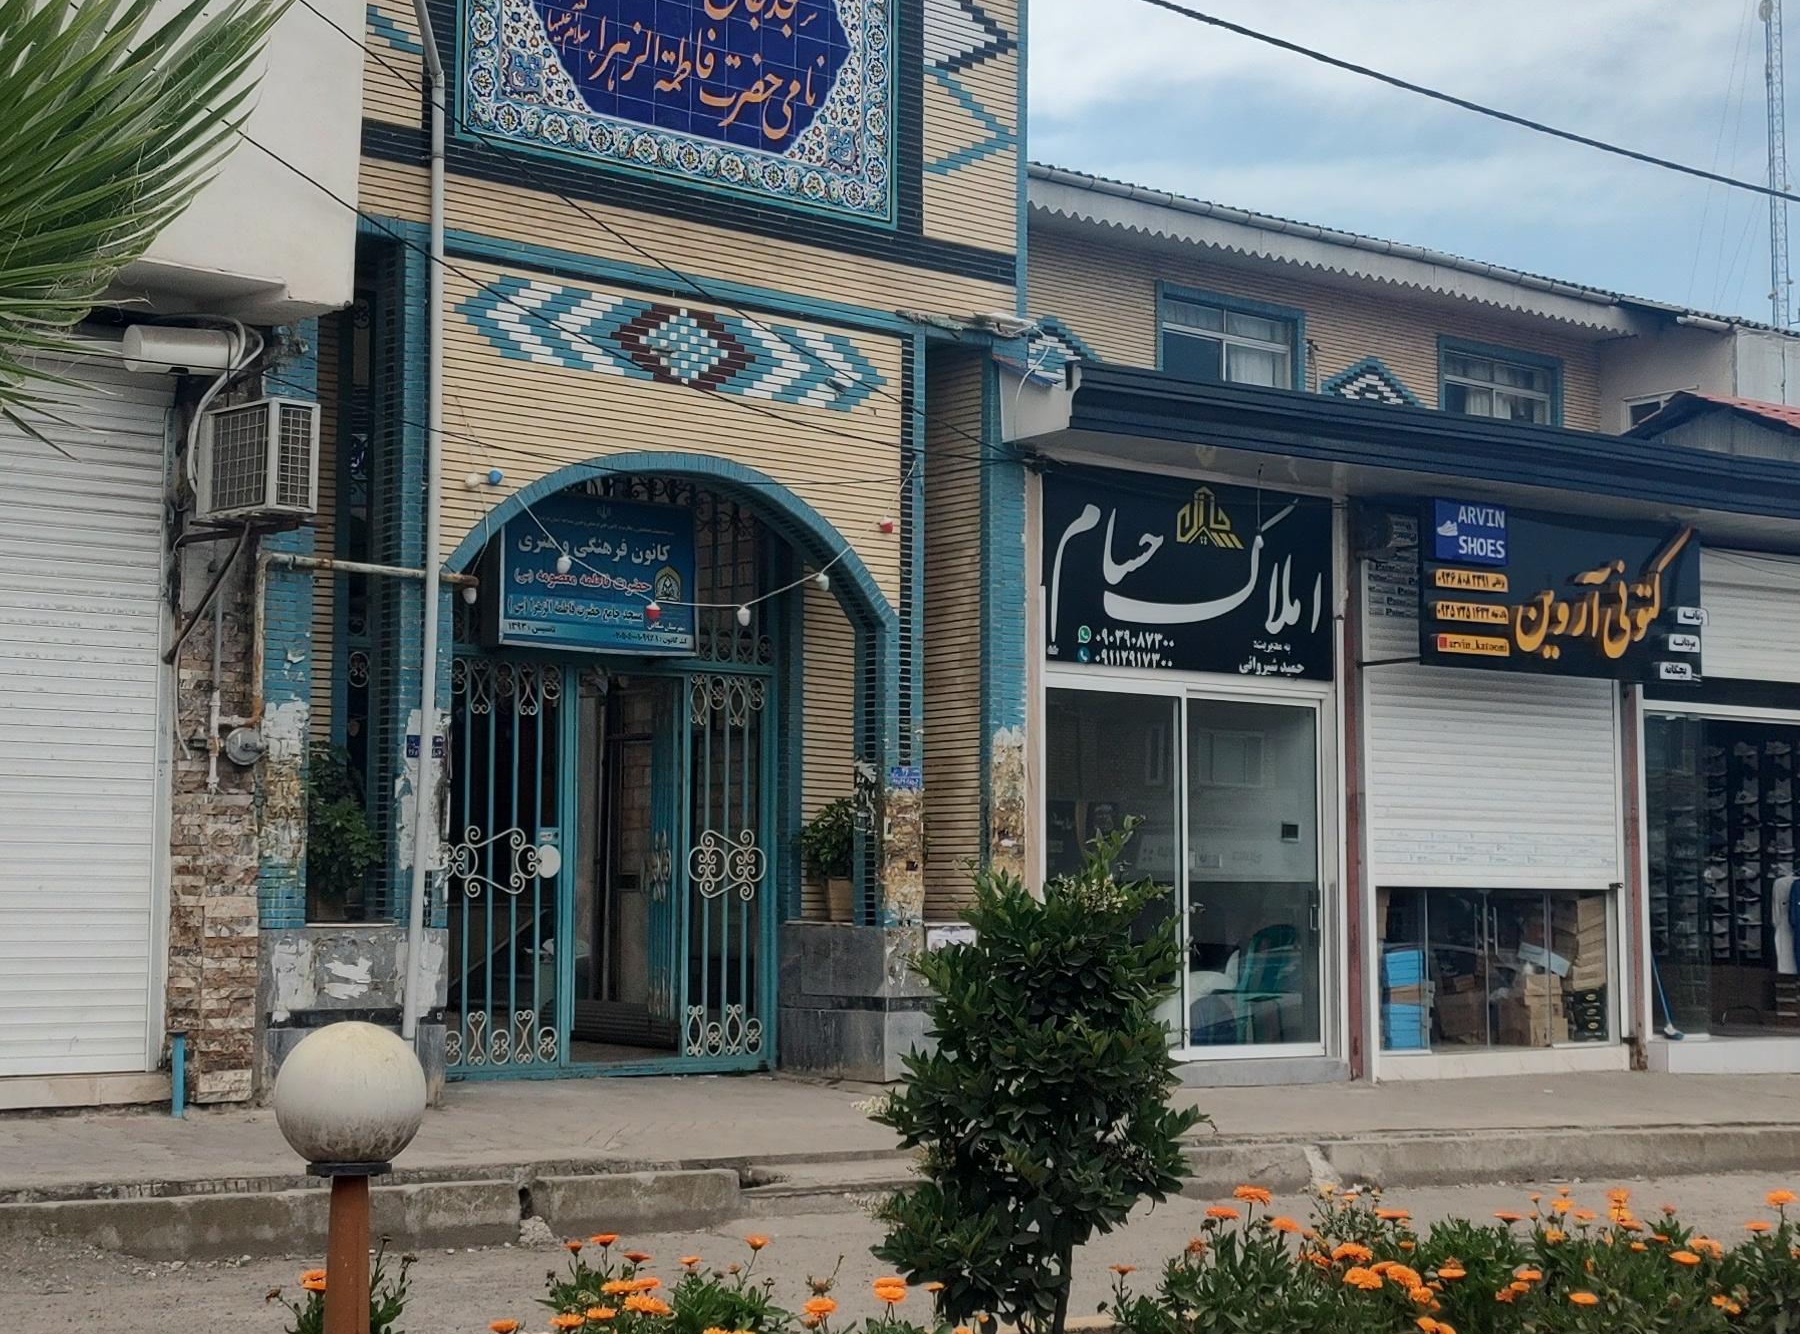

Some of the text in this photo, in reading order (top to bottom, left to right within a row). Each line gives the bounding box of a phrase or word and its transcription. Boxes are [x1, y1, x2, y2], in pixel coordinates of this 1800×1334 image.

[700, 53, 784, 127] حضرت
[763, 55, 825, 139] نامی
[1458, 505, 1505, 529] ARVIN
[574, 537, 627, 562] فرهنگی
[631, 543, 671, 565] کانون
[1458, 536, 1506, 558] SHOES
[1103, 498, 1322, 635] املاک
[1602, 527, 1692, 659] کتونی
[1280, 662, 1305, 676] حمید
